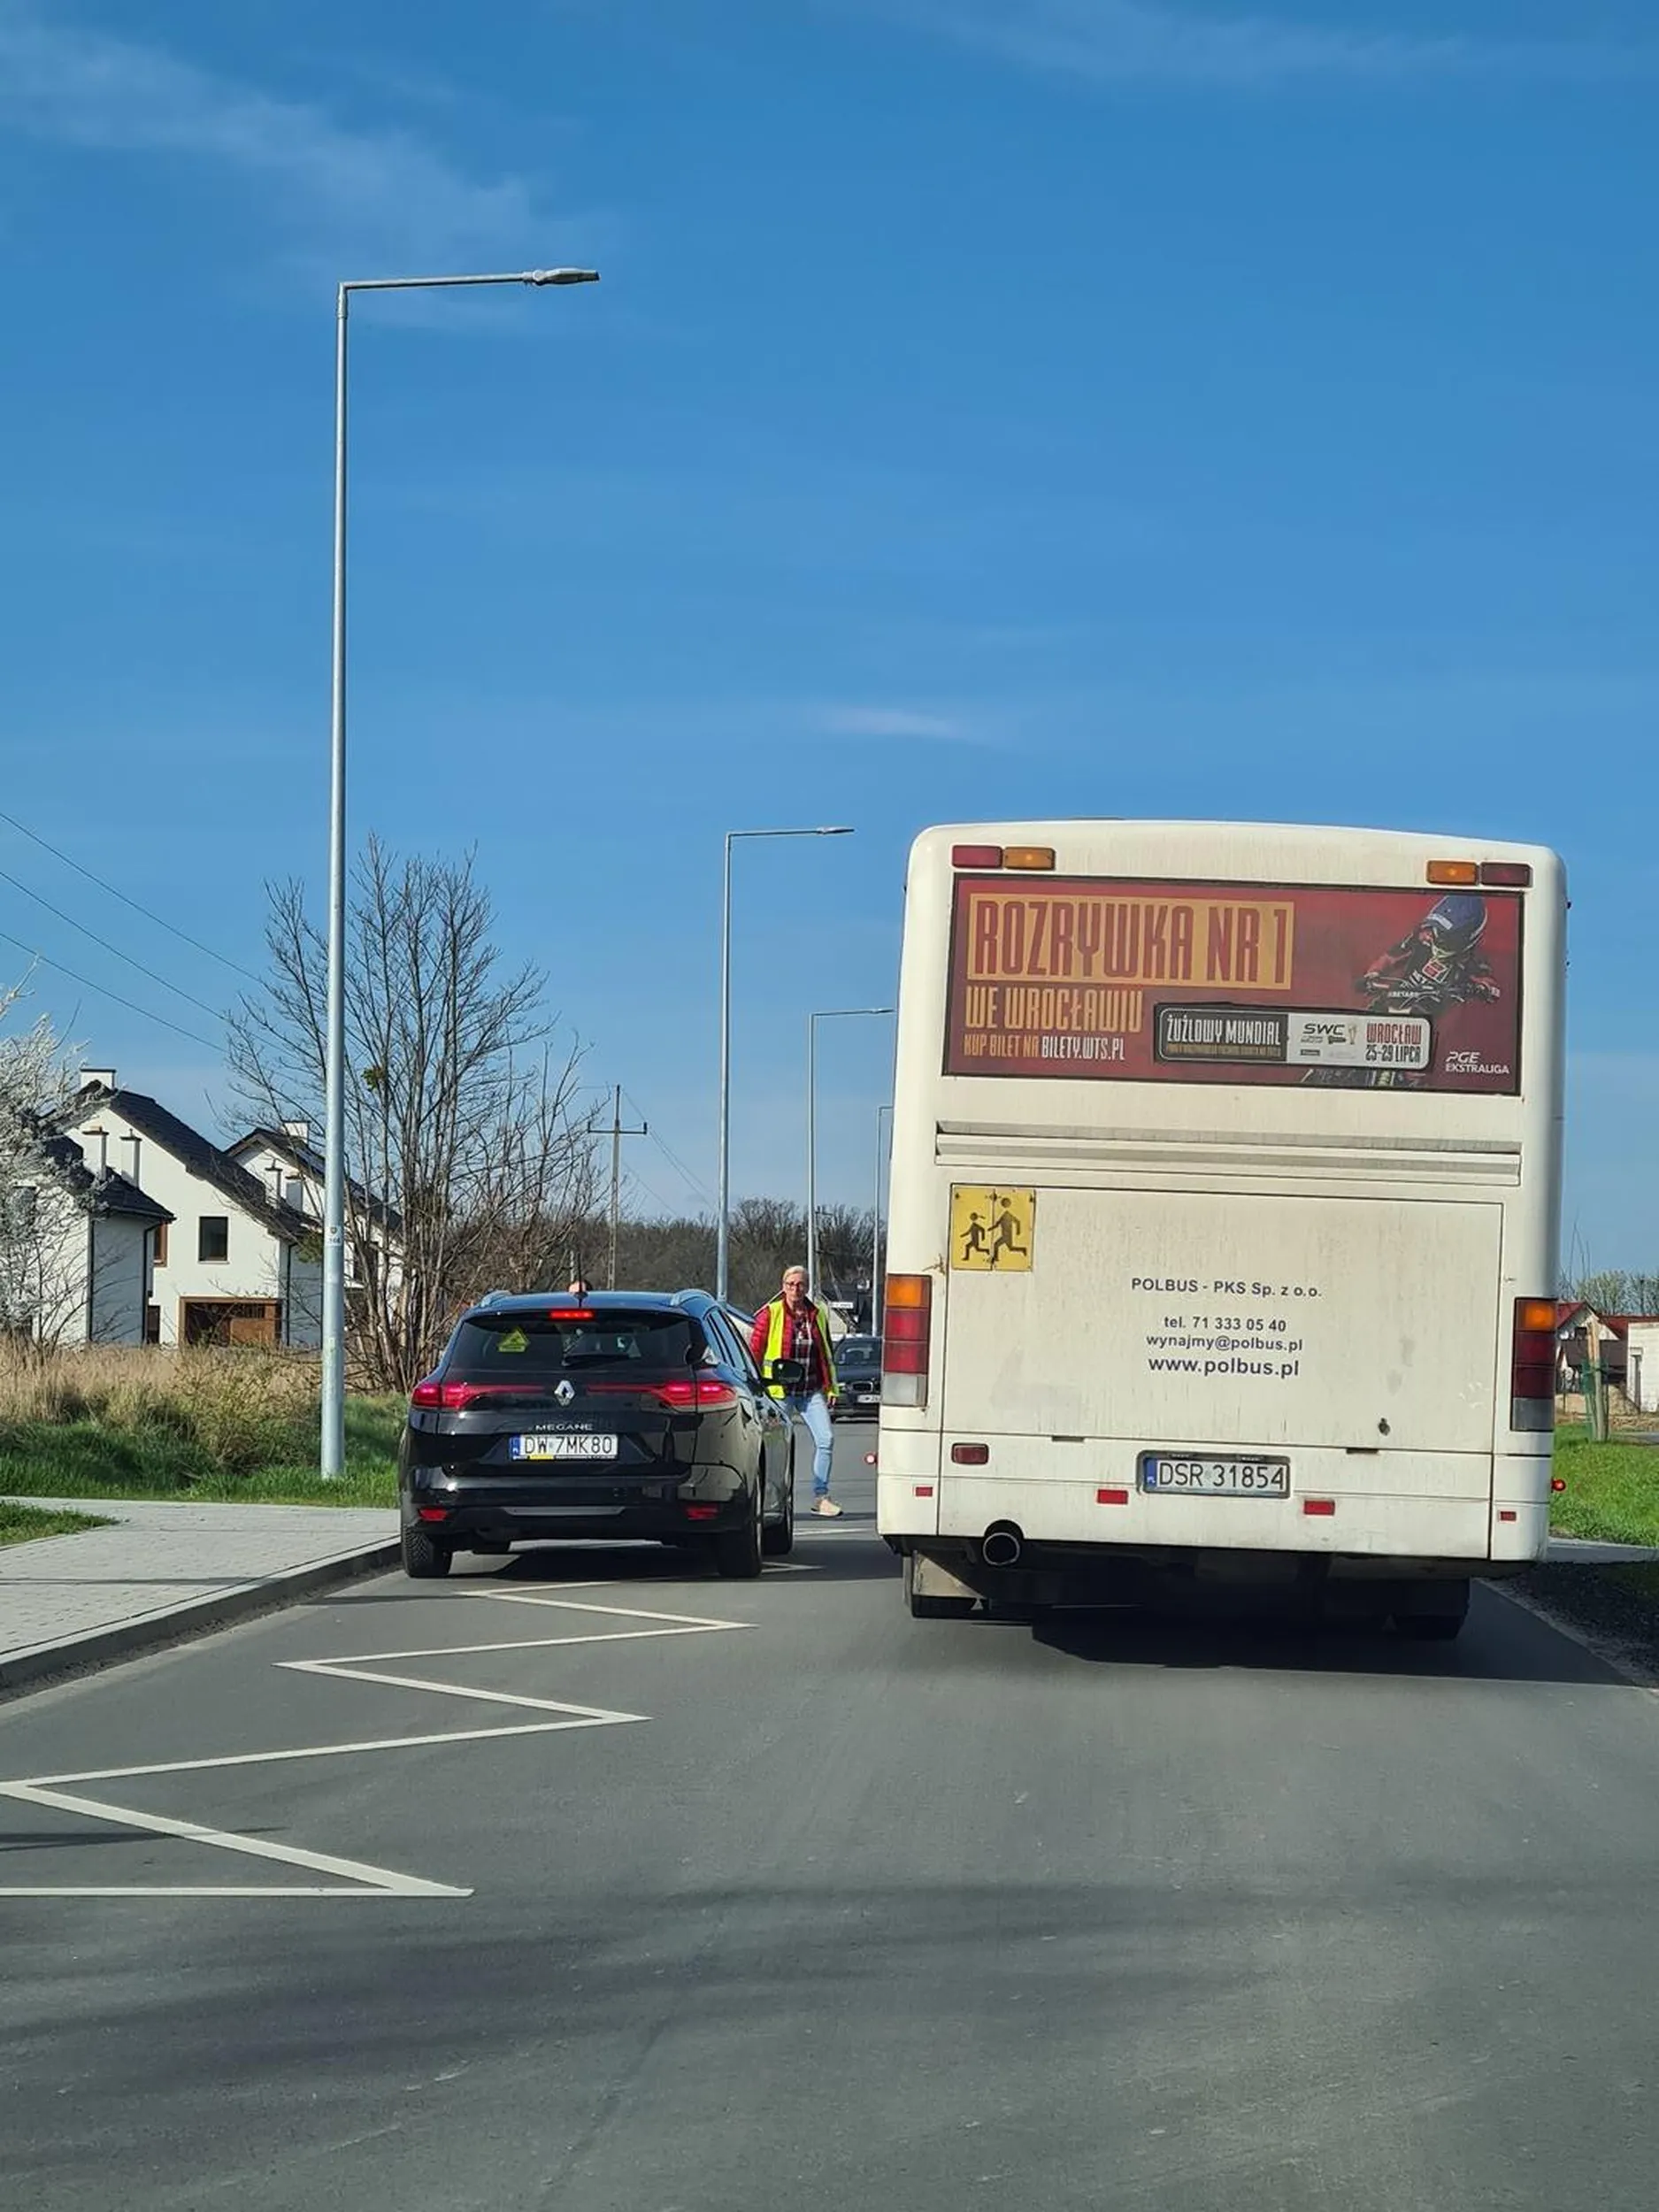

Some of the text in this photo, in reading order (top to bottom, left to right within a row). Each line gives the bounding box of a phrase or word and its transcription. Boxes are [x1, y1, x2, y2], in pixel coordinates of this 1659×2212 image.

[975, 901, 1287, 984] ROZRYWKA NR 1
[965, 986, 1142, 1033] WE WROCŁAWIU
[1167, 1015, 1280, 1045] ŻUŹLOWY MUNDIAL
[1302, 1023, 1345, 1035] SWC
[1366, 1023, 1422, 1044] WROCŁAW
[964, 1033, 1125, 1060] KUP BILET NA BILETY.WTS.PL
[1365, 1044, 1394, 1062] 25-29
[1446, 1051, 1481, 1063] PGE
[1445, 1064, 1509, 1074] EKSTRALIGA
[1132, 1278, 1198, 1293] POLBUS
[1213, 1280, 1246, 1294] PKS
[1251, 1282, 1276, 1297] Sp.
[1280, 1286, 1289, 1296] z
[1294, 1286, 1322, 1297] o.o.
[1164, 1316, 1286, 1332] tel. 71 333 05 40
[1146, 1334, 1303, 1353] wynajmy@polbus.pl
[1148, 1357, 1299, 1379] www.polbus.pl
[525, 1435, 612, 1454] DW 7MK80
[1159, 1463, 1284, 1490] DSR 31854
